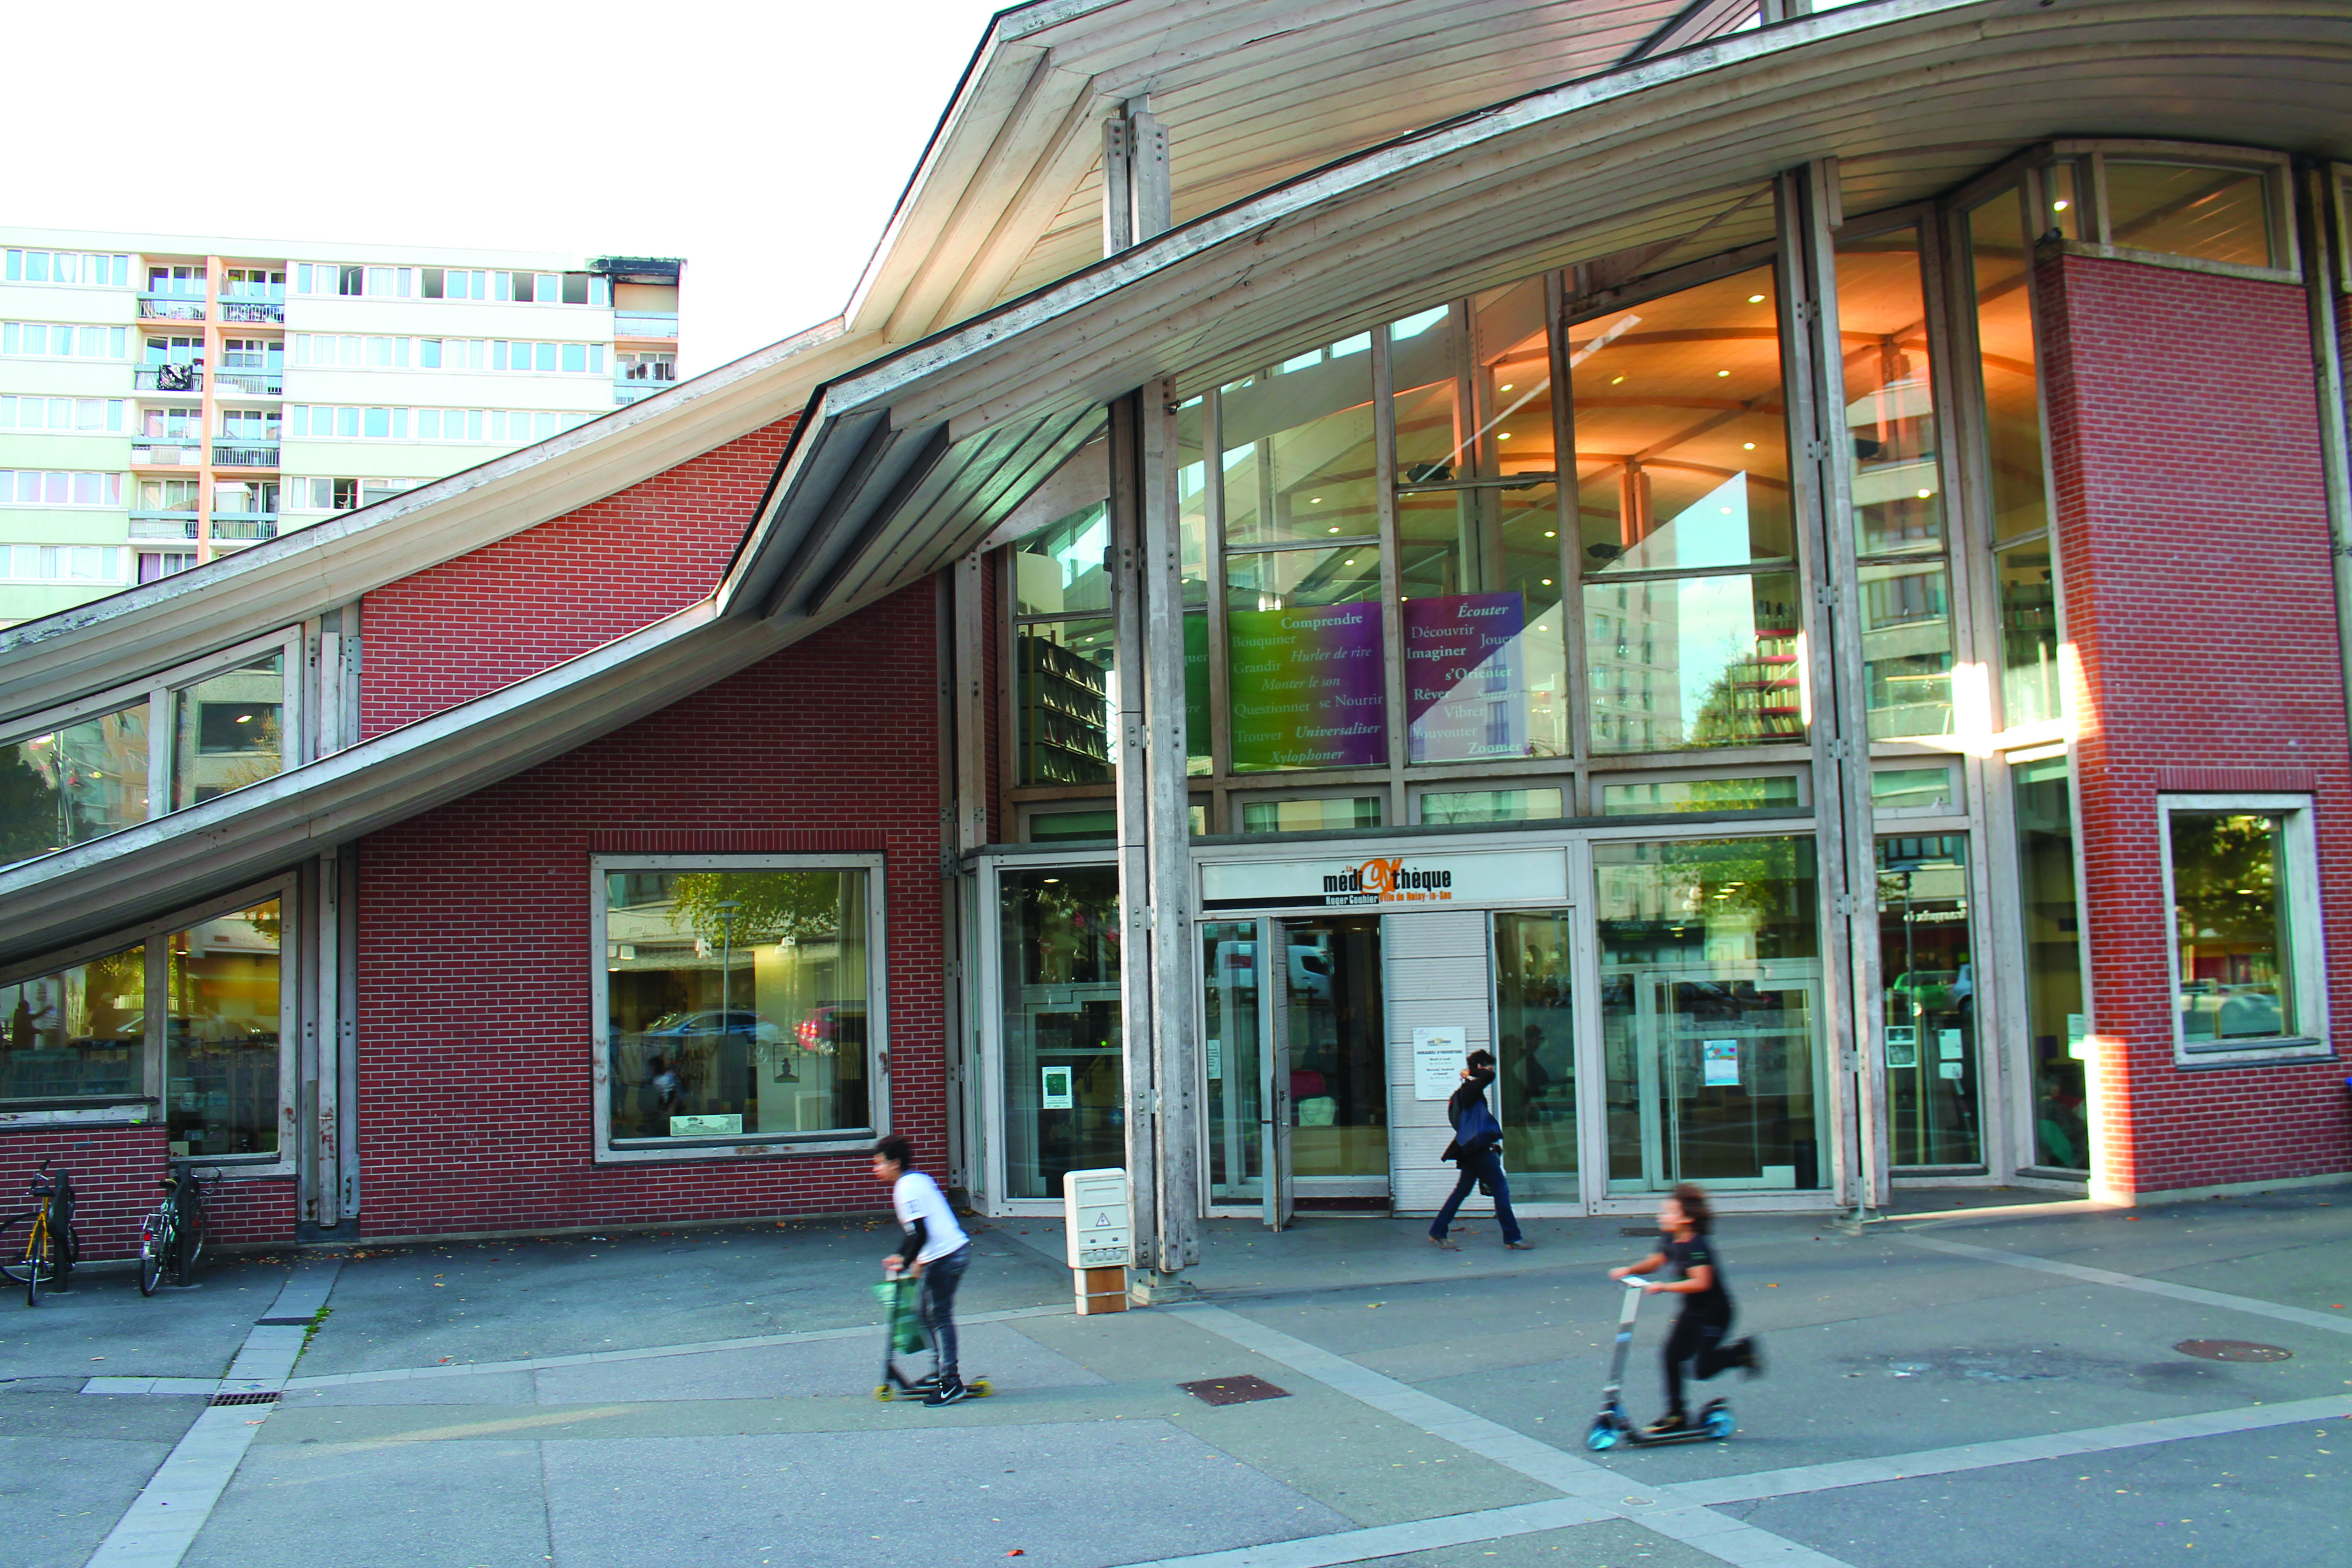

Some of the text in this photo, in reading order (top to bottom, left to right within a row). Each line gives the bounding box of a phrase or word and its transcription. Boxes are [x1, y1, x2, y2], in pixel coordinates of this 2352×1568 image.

[1457, 602, 1509, 618] Écouter
[1281, 613, 1363, 630] Comprendre
[1411, 624, 1475, 639] Découvrir
[1233, 634, 1297, 649] Bouquiner
[1479, 633, 1513, 649] Jouer
[1291, 646, 1372, 662] Hurler de rire
[1406, 646, 1467, 661] Imaginer
[1233, 660, 1282, 674] Grandir
[1261, 676, 1341, 691] Monter le son
[1319, 694, 1383, 709] se Nourrir
[1413, 688, 1451, 700] Rêver
[1234, 703, 1311, 718] Questionner
[1444, 706, 1485, 718] Vibrer
[1234, 731, 1283, 743] Trouver
[1295, 722, 1381, 738] Universaliser
[1468, 742, 1522, 754] Zoomer
[1269, 748, 1344, 766] Xylophoner
[1326, 895, 1378, 905] Roger Gouhier
